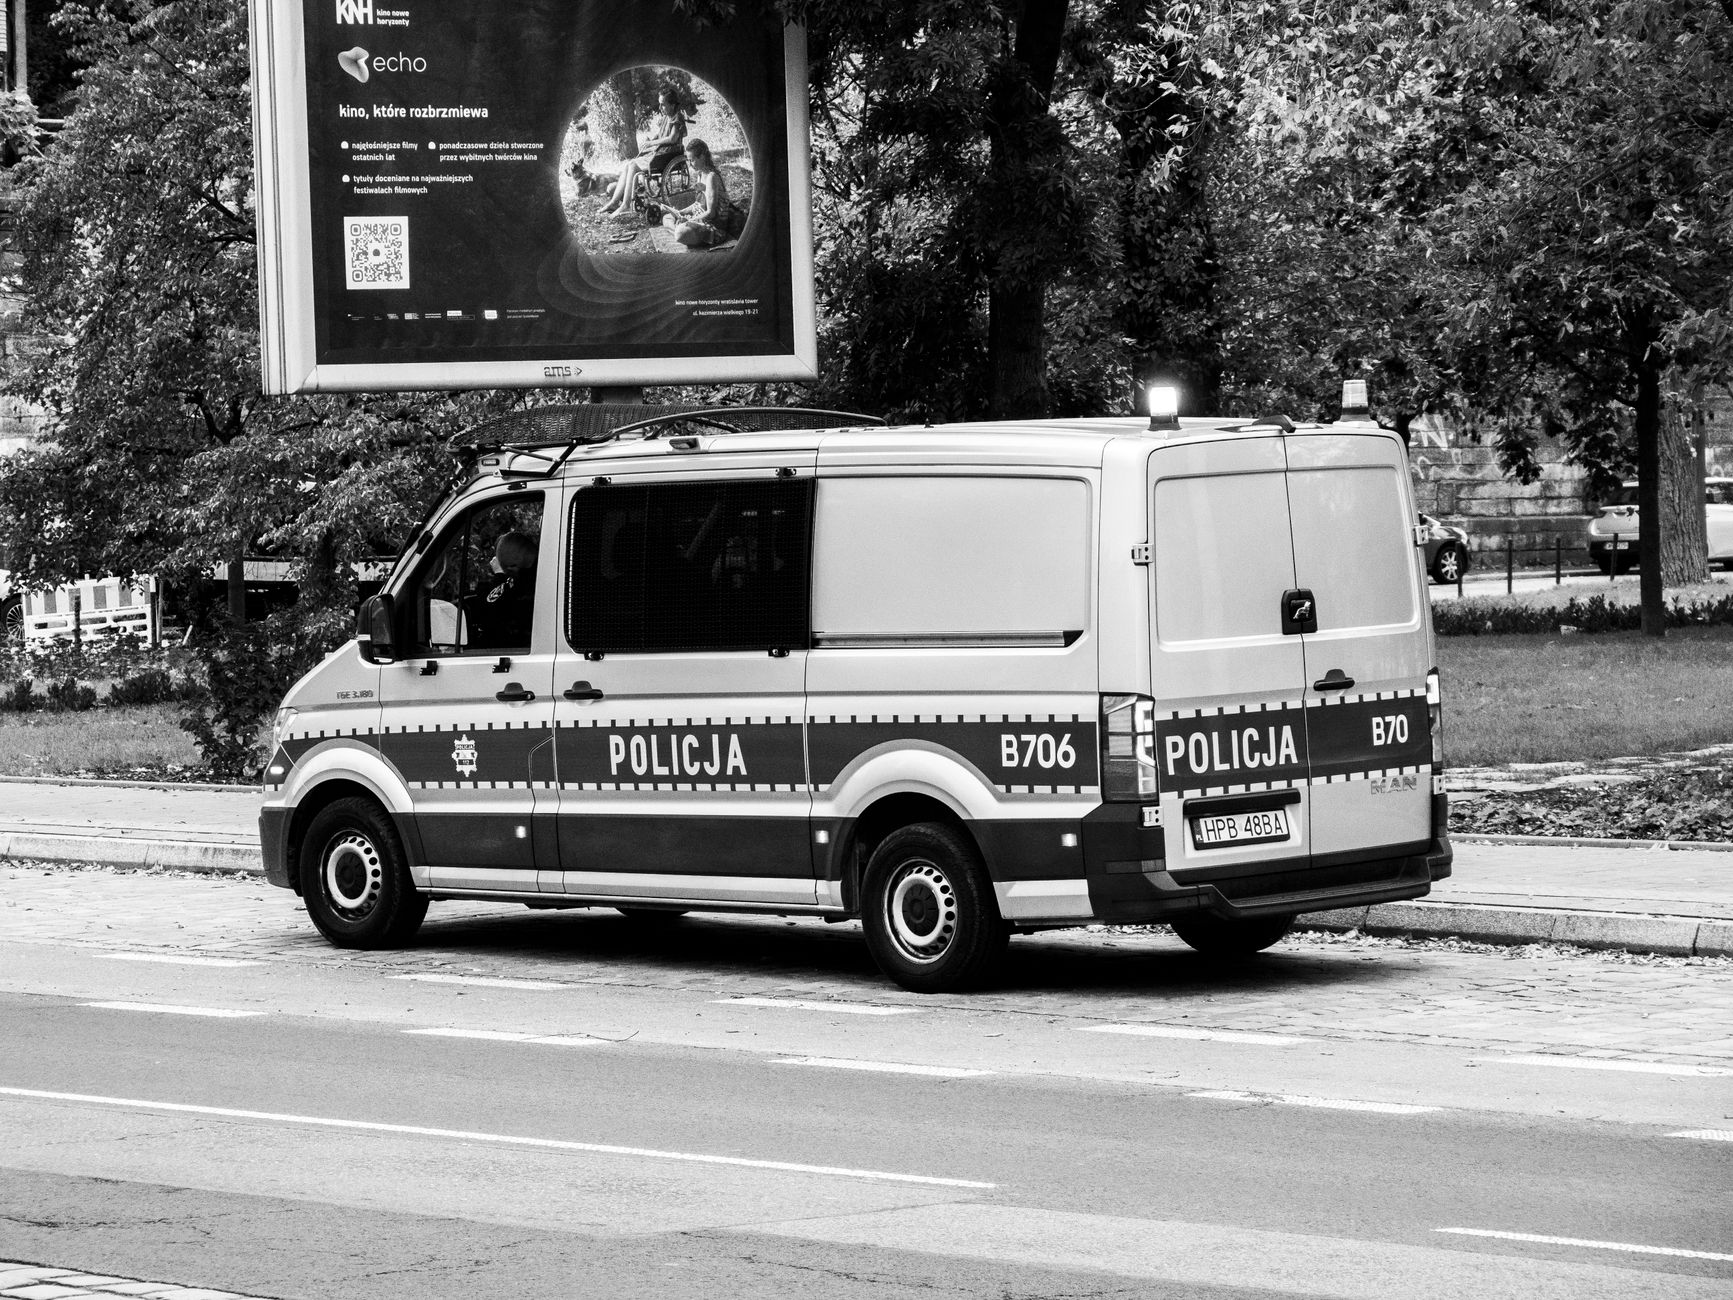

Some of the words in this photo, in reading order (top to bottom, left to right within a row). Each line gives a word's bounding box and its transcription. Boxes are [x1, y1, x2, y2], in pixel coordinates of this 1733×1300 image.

[336, 0, 373, 24] KNH
[377, 17, 410, 27] horyzonty
[373, 51, 427, 72] echo
[339, 104, 369, 119] kino,
[373, 104, 406, 118] które
[409, 104, 488, 118] rozbrzmiewa
[402, 141, 418, 151] filmy
[439, 141, 488, 151] ponadczasowe
[489, 141, 509, 149] dzieła
[440, 154, 458, 162] przez
[459, 153, 493, 162] wybitnych
[353, 175, 373, 184] tytuły
[375, 174, 410, 182] doceniane
[420, 174, 473, 183] najważniejszych
[353, 186, 393, 194] festiwalach
[394, 185, 428, 195] filmowych
[544, 366, 571, 376] ams
[1371, 714, 1409, 746] B70
[609, 733, 748, 776] POLICJA
[1001, 733, 1077, 769] B706
[1165, 725, 1299, 776] POLICJA
[1370, 775, 1417, 795] MAN
[1204, 817, 1239, 841] HPB
[1244, 813, 1284, 837] 48BA
